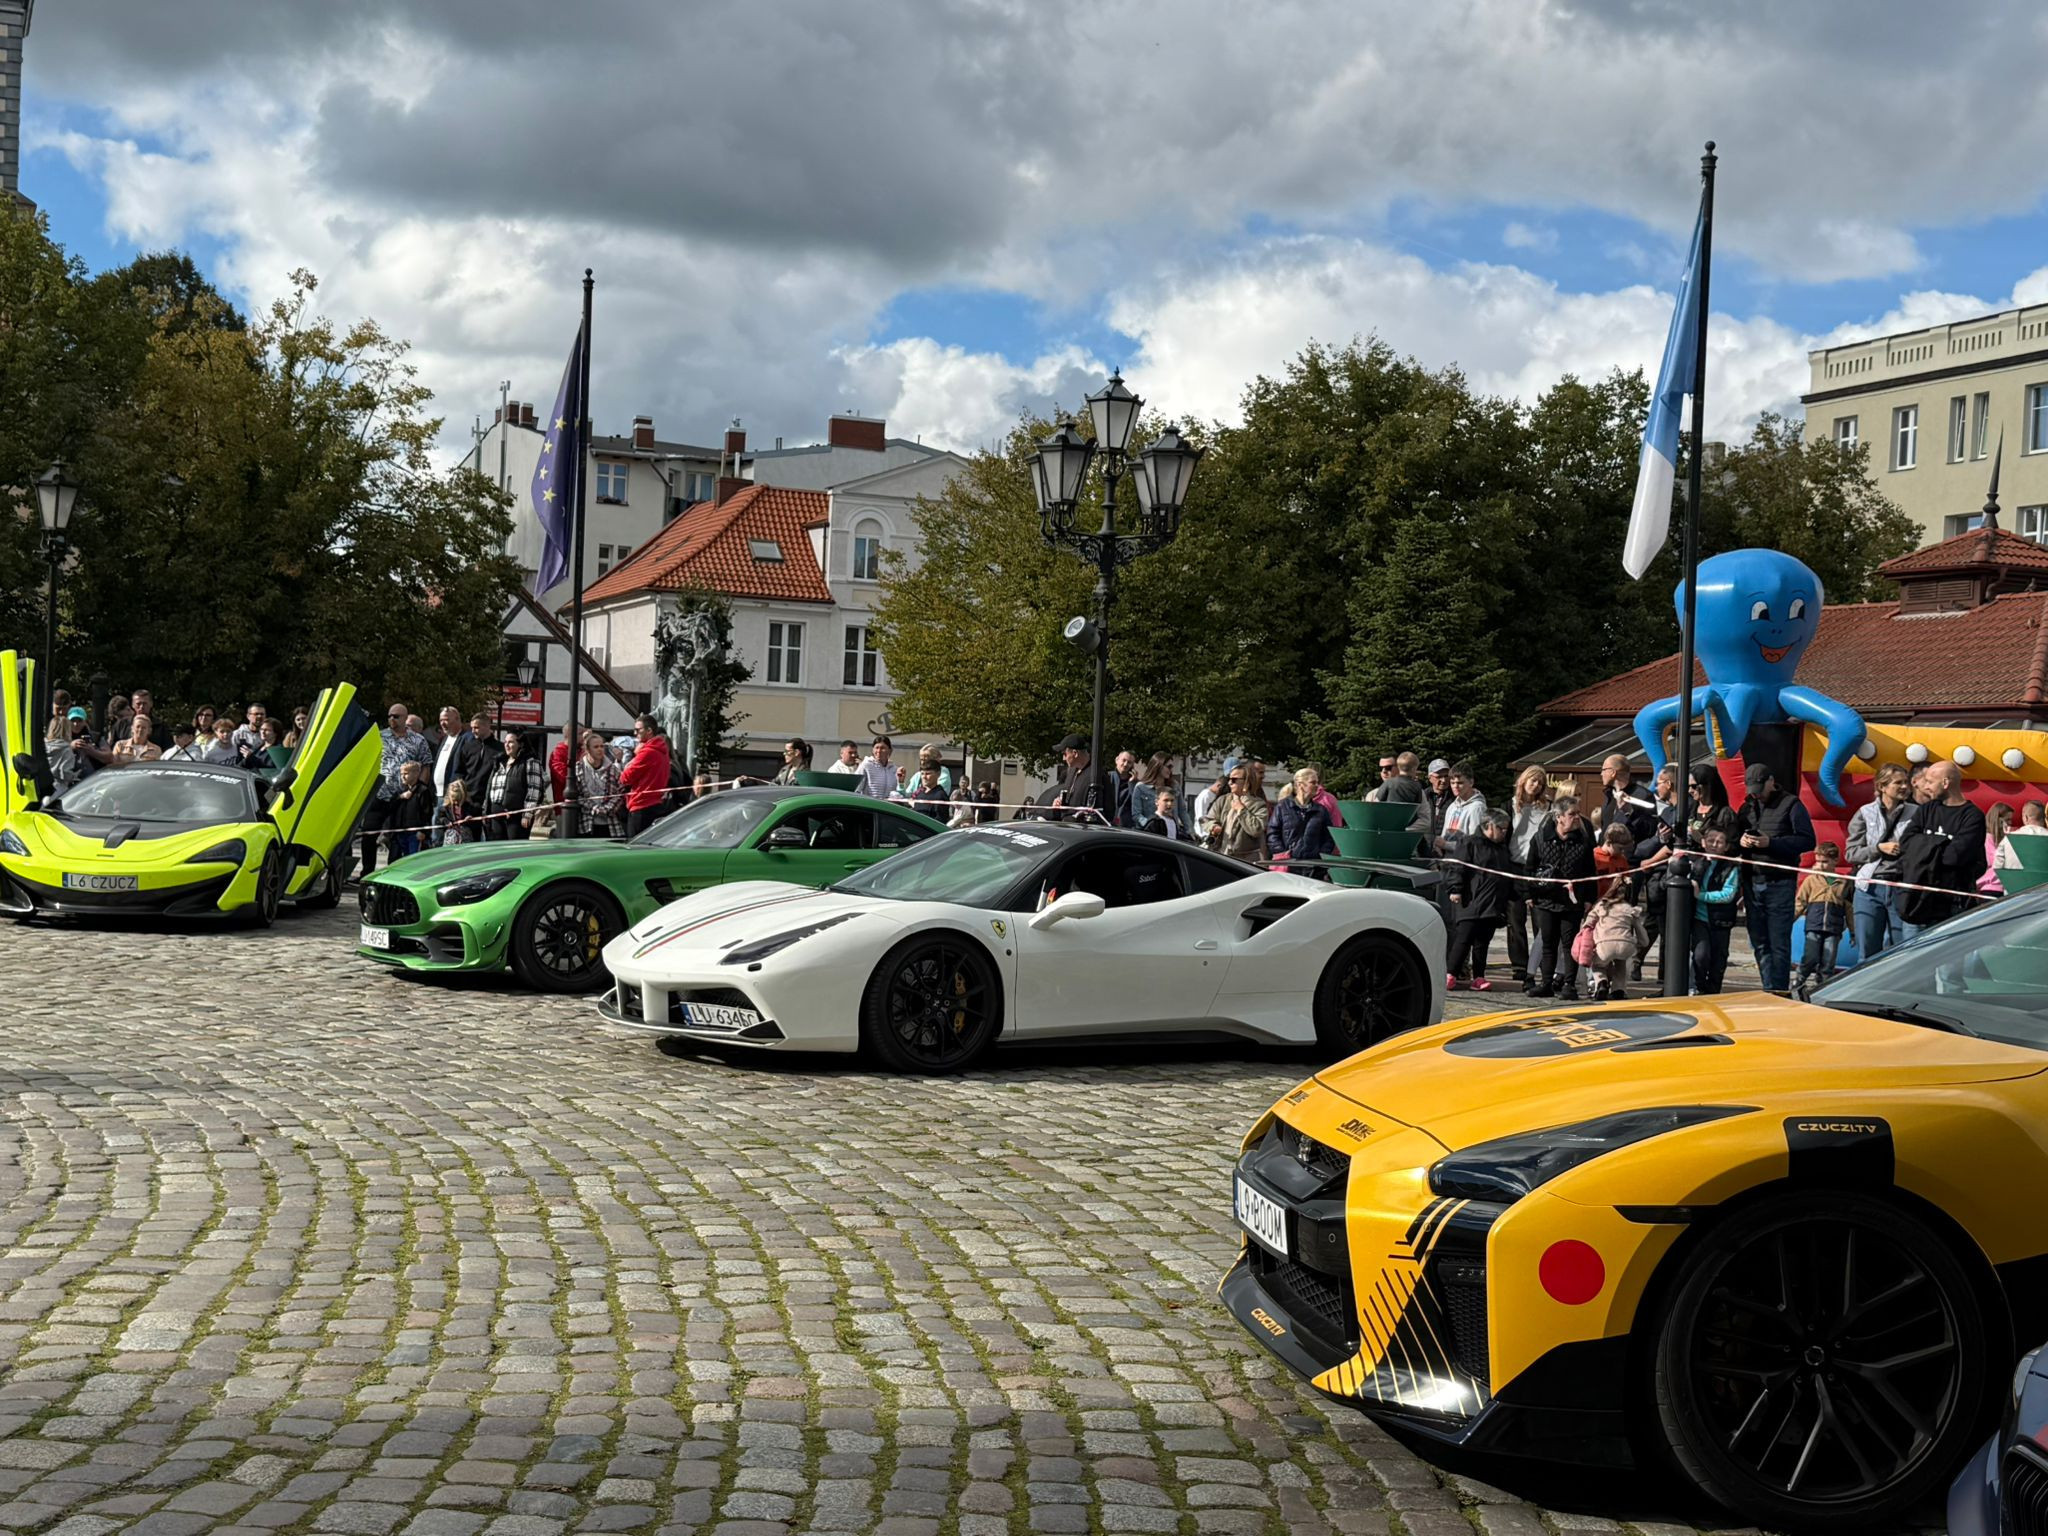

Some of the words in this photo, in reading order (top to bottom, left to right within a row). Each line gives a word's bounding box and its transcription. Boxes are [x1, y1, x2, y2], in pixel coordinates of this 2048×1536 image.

[70, 874, 86, 888] L6
[91, 876, 136, 889] CZUCZ
[1253, 1193, 1284, 1248] BOOM
